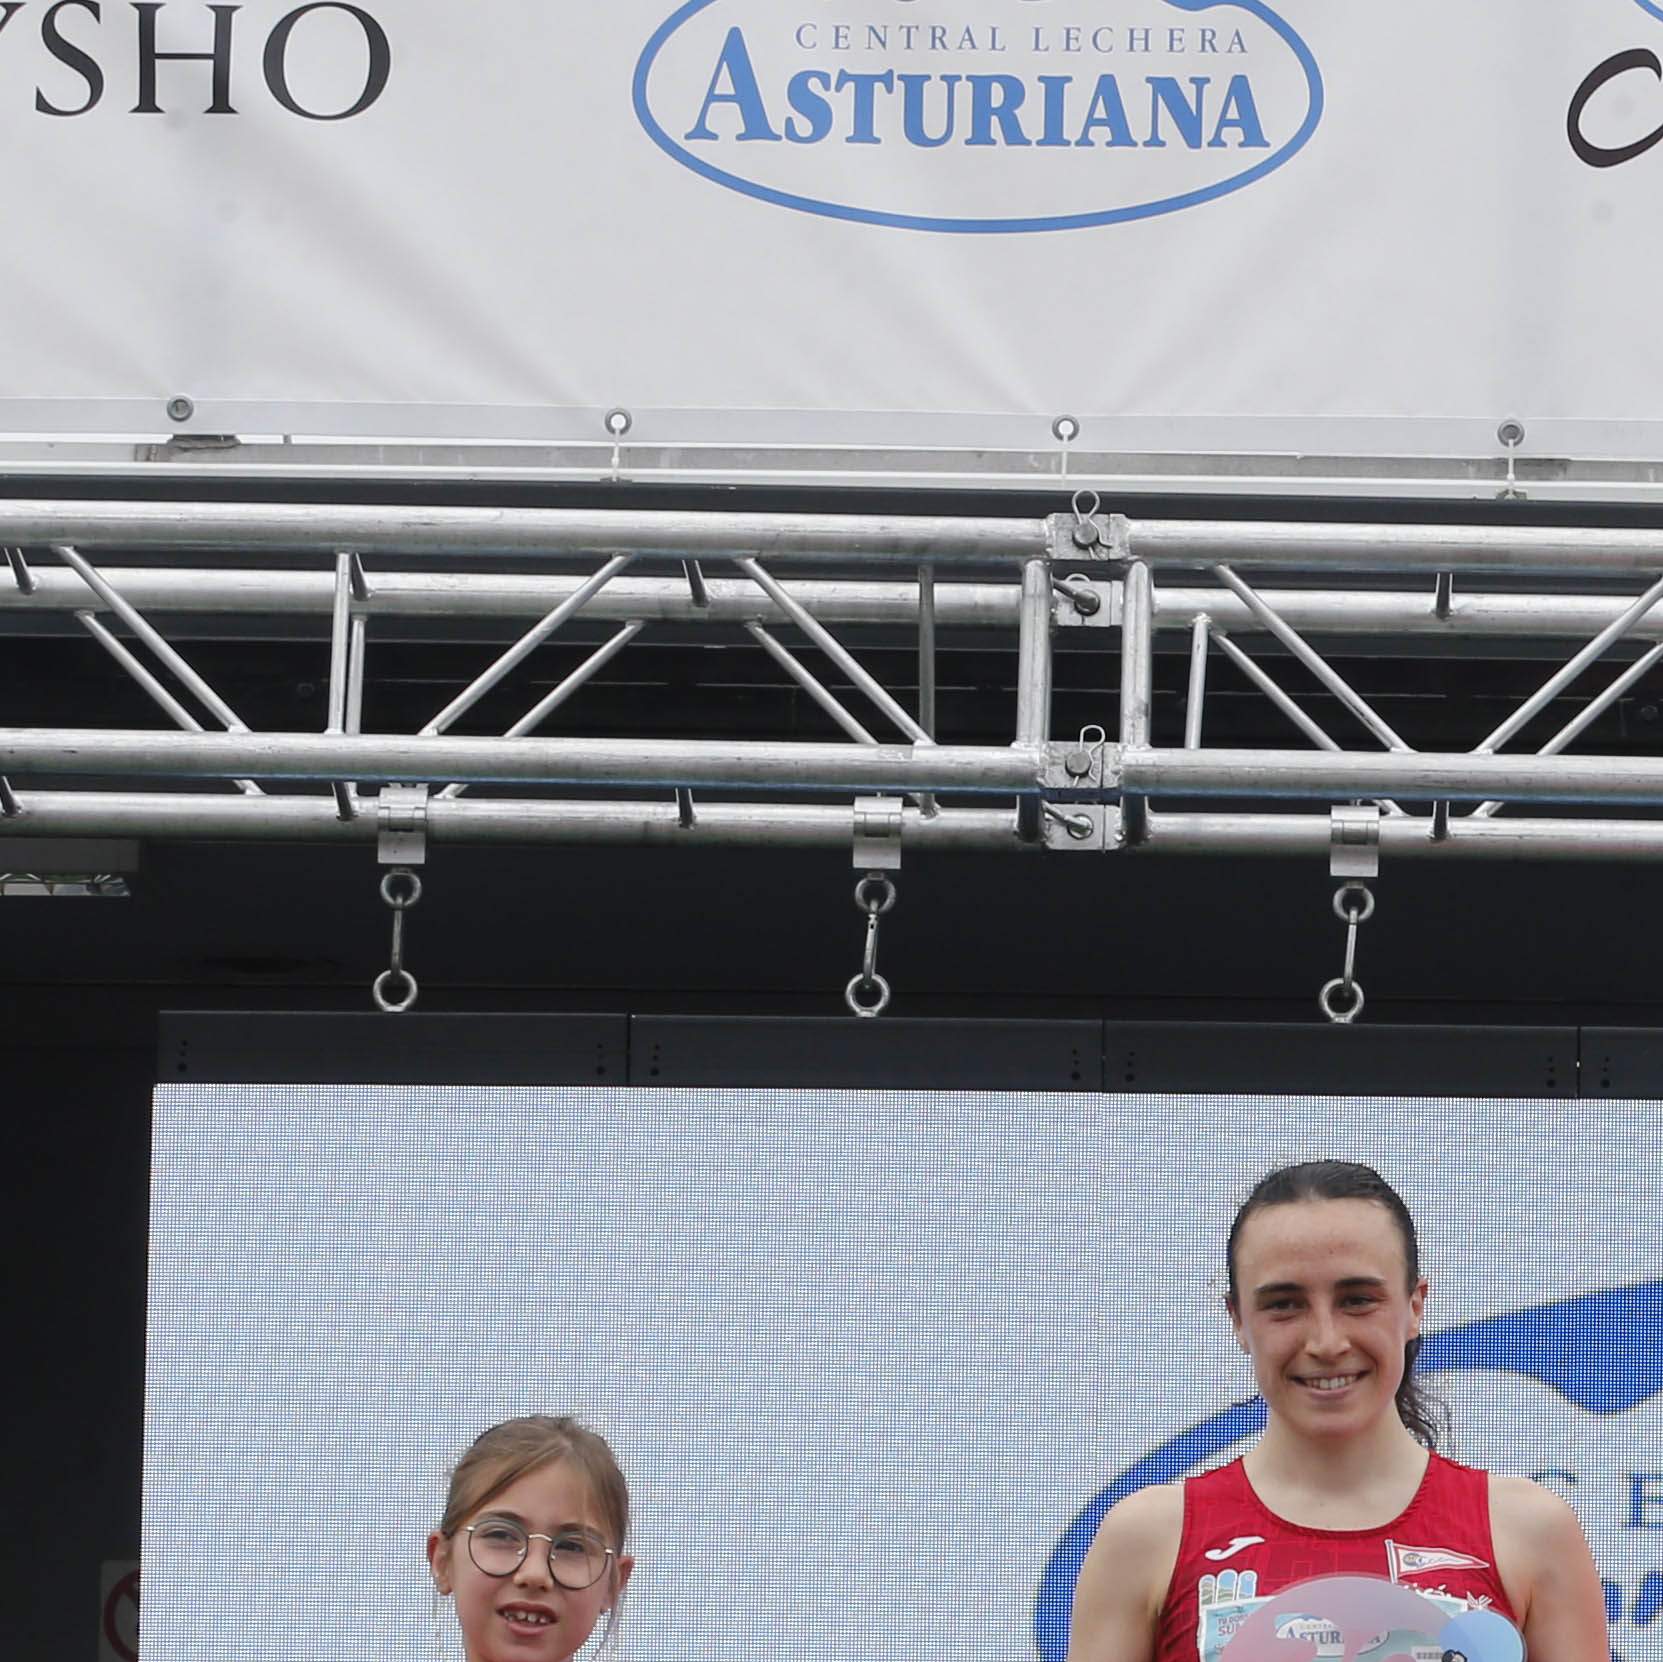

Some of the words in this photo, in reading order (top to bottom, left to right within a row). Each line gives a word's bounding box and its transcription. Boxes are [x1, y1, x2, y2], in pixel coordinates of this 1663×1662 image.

[0, 0, 391, 121] SHO
[685, 27, 1270, 149] ASTURIANA
[795, 22, 1007, 53] CENTRAL
[1031, 28, 1247, 55] LECHERA
